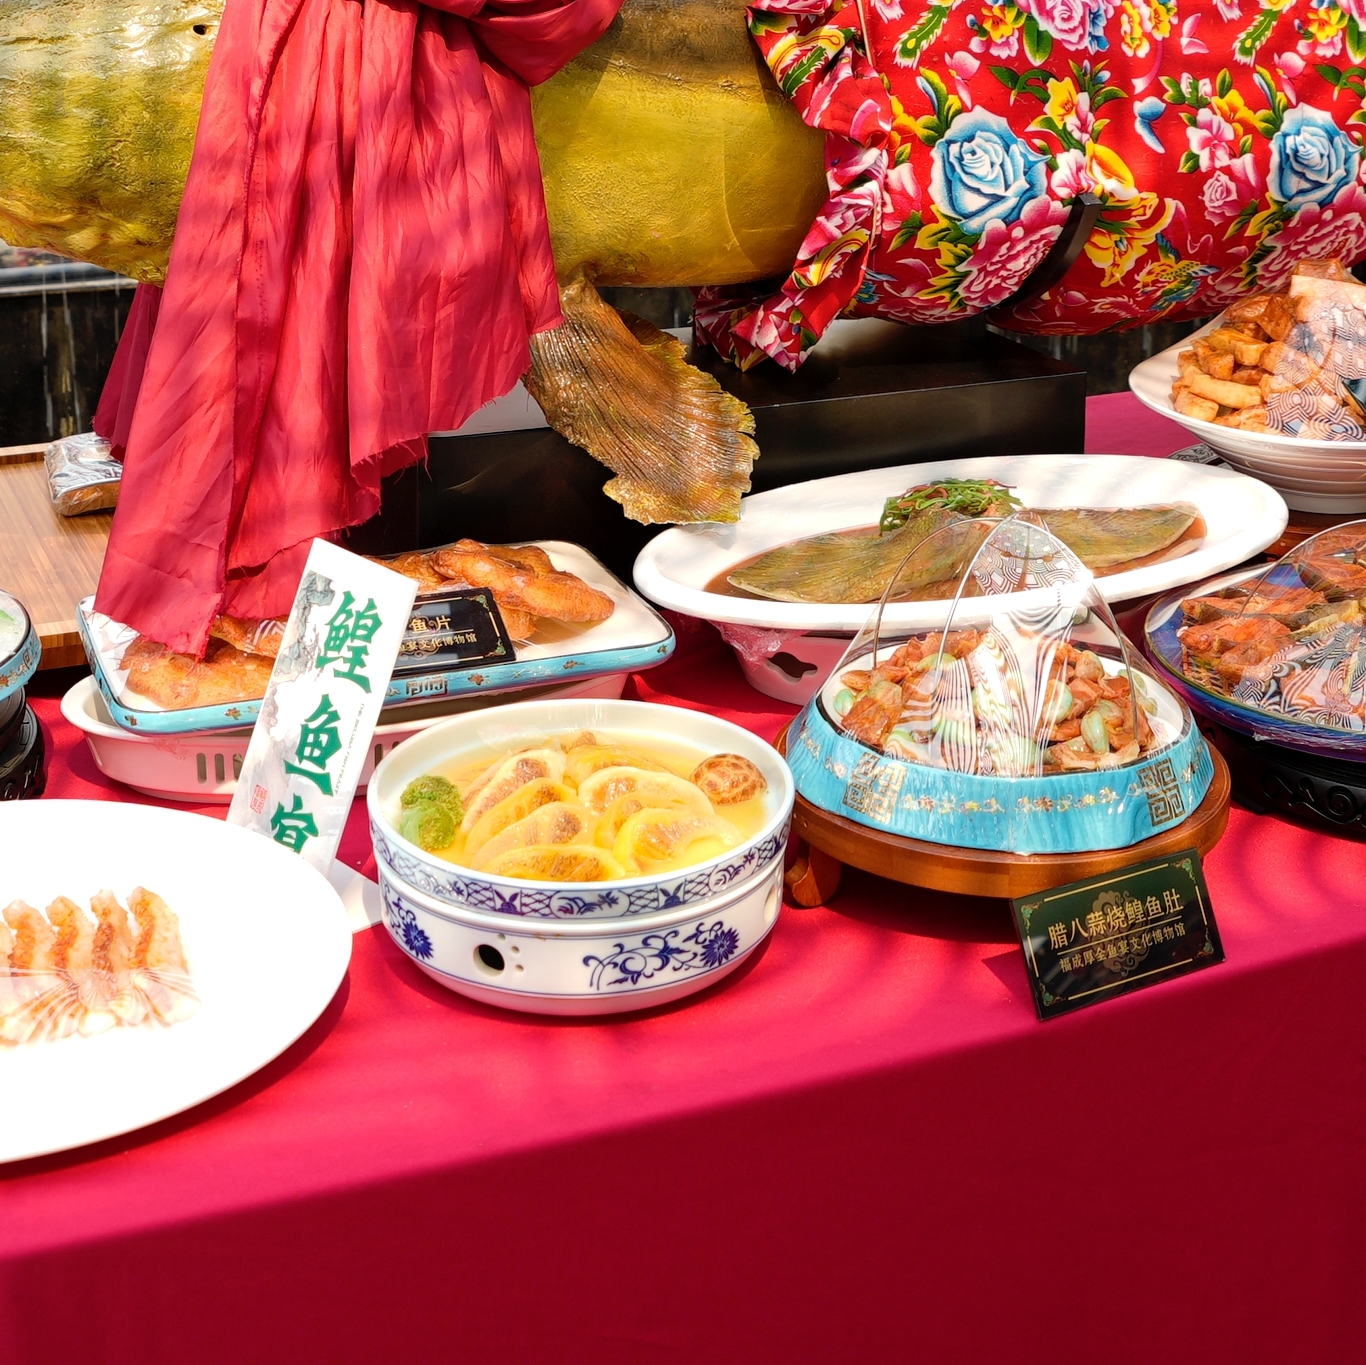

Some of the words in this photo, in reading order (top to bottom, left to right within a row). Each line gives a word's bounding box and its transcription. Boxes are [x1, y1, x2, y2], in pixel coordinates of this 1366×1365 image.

[1047, 887, 1184, 951] 腊八蒜烧鳇鱼肚
[1058, 921, 1186, 974] 福成厚全鱼宴文化博物馆
